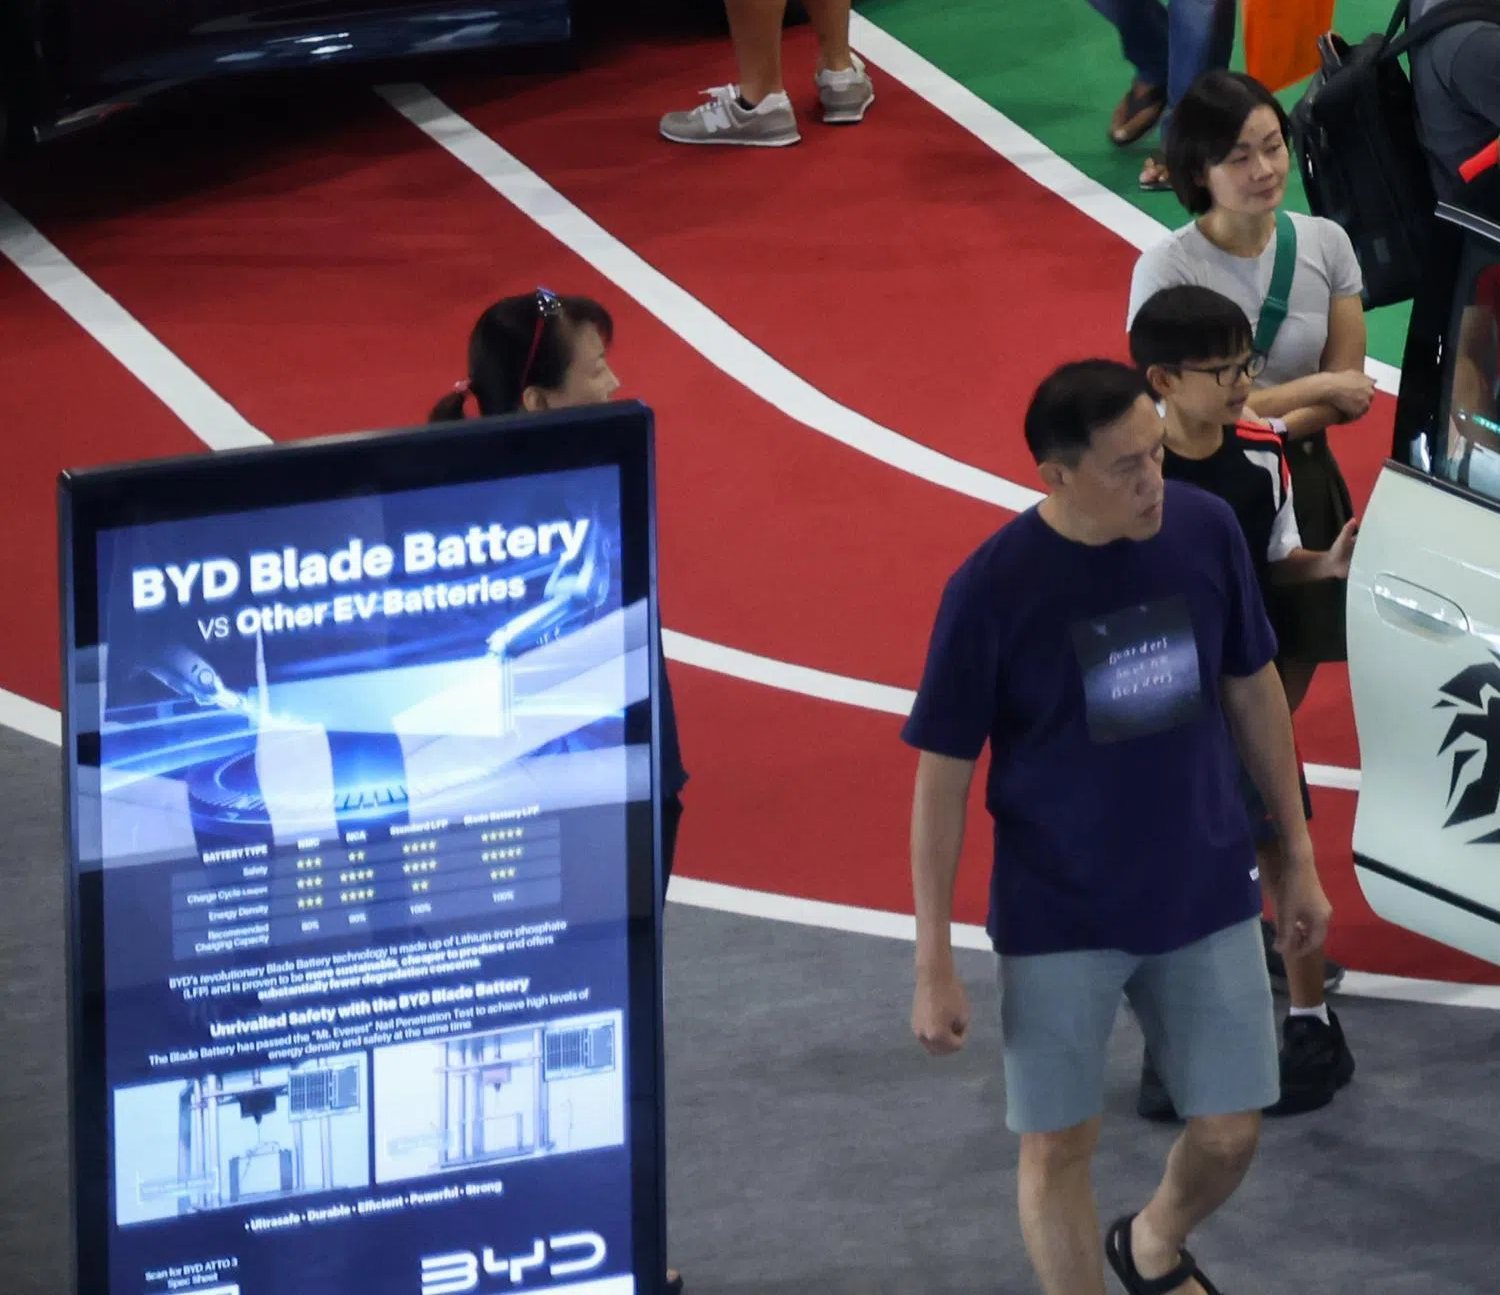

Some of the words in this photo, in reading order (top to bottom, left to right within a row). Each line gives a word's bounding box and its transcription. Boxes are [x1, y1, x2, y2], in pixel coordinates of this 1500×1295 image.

[132, 558, 239, 609] BYD
[250, 538, 393, 595] Blade
[404, 517, 590, 575] Battery
[237, 602, 328, 635] Other
[333, 595, 374, 623] EV
[383, 573, 527, 617] Batteries
[203, 849, 243, 863] BATTERY
[245, 845, 268, 857] TYPE
[210, 1014, 287, 1038] Unrivalled
[288, 1007, 336, 1026] Safety
[337, 1000, 371, 1019] with
[372, 996, 398, 1012] the
[399, 992, 430, 1009] BYD
[431, 985, 474, 1005] Blade
[474, 978, 530, 1002] Battery
[250, 1213, 301, 1231] Ultrasafe
[307, 1205, 351, 1222] Durable
[358, 1195, 404, 1214] Efficient
[409, 1186, 460, 1205] Powerful
[466, 1181, 503, 1197] Strong
[421, 1230, 607, 1294] BYD
